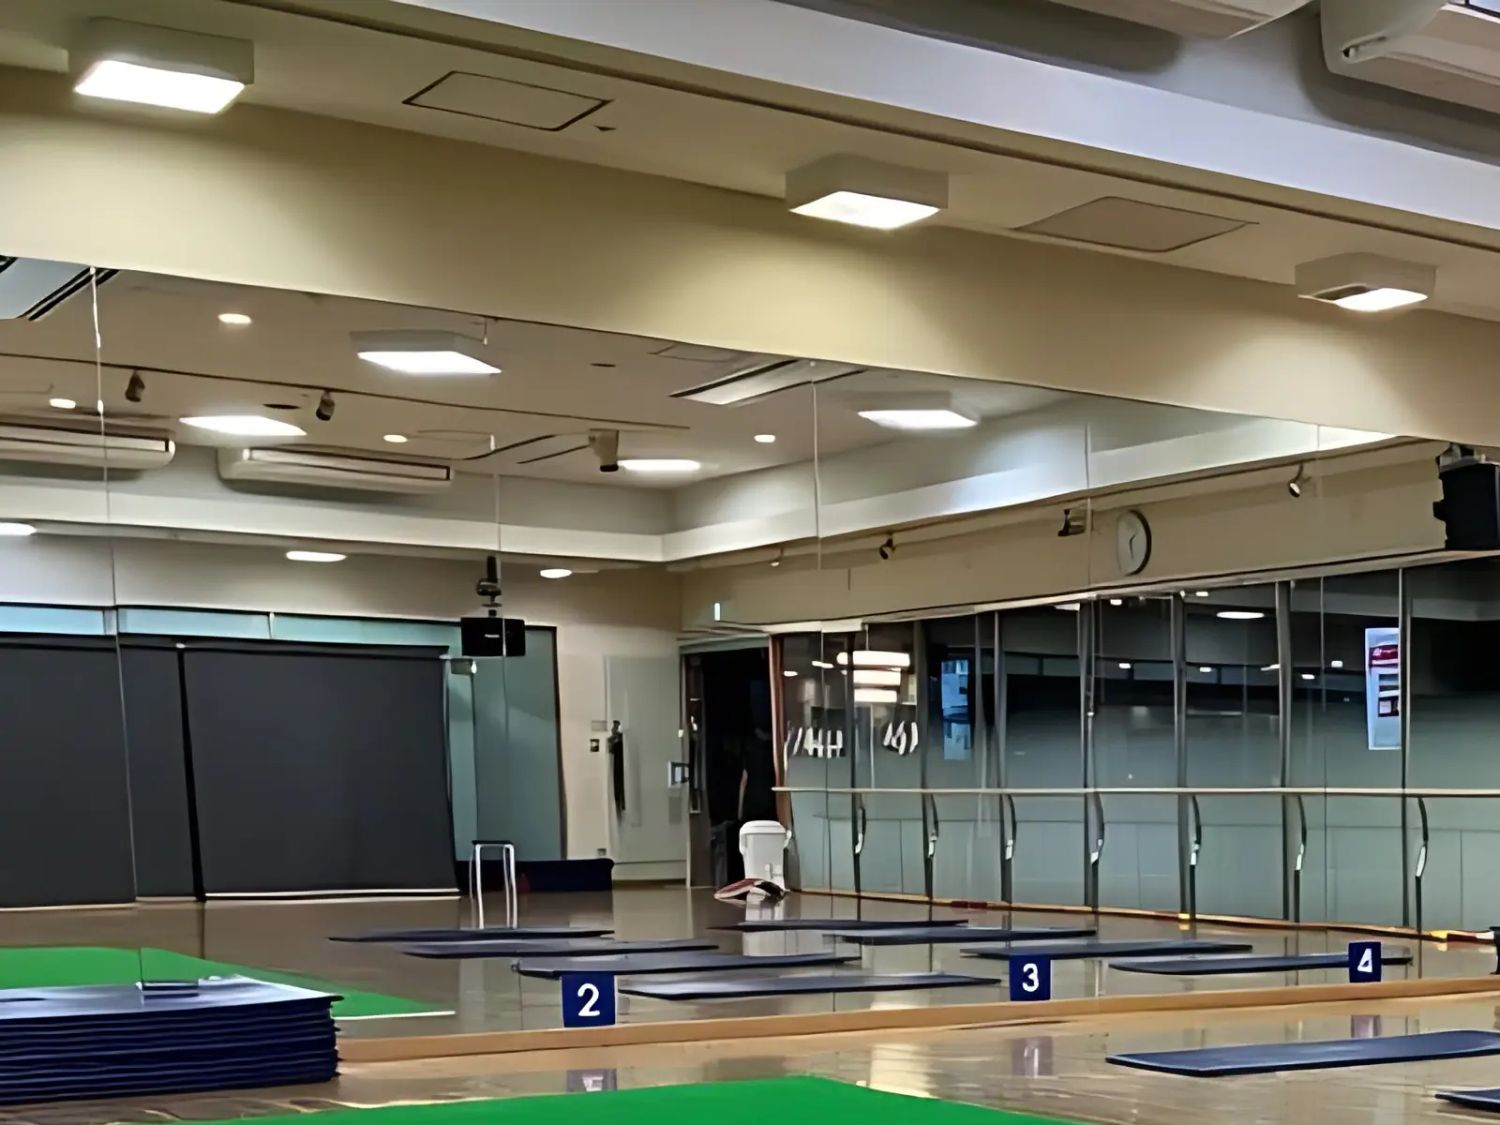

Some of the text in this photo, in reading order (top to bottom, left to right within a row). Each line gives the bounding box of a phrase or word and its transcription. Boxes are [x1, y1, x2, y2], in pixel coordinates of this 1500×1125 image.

[1356, 947, 1373, 973] 4
[1022, 962, 1040, 993] 3
[577, 982, 601, 1017] 2
